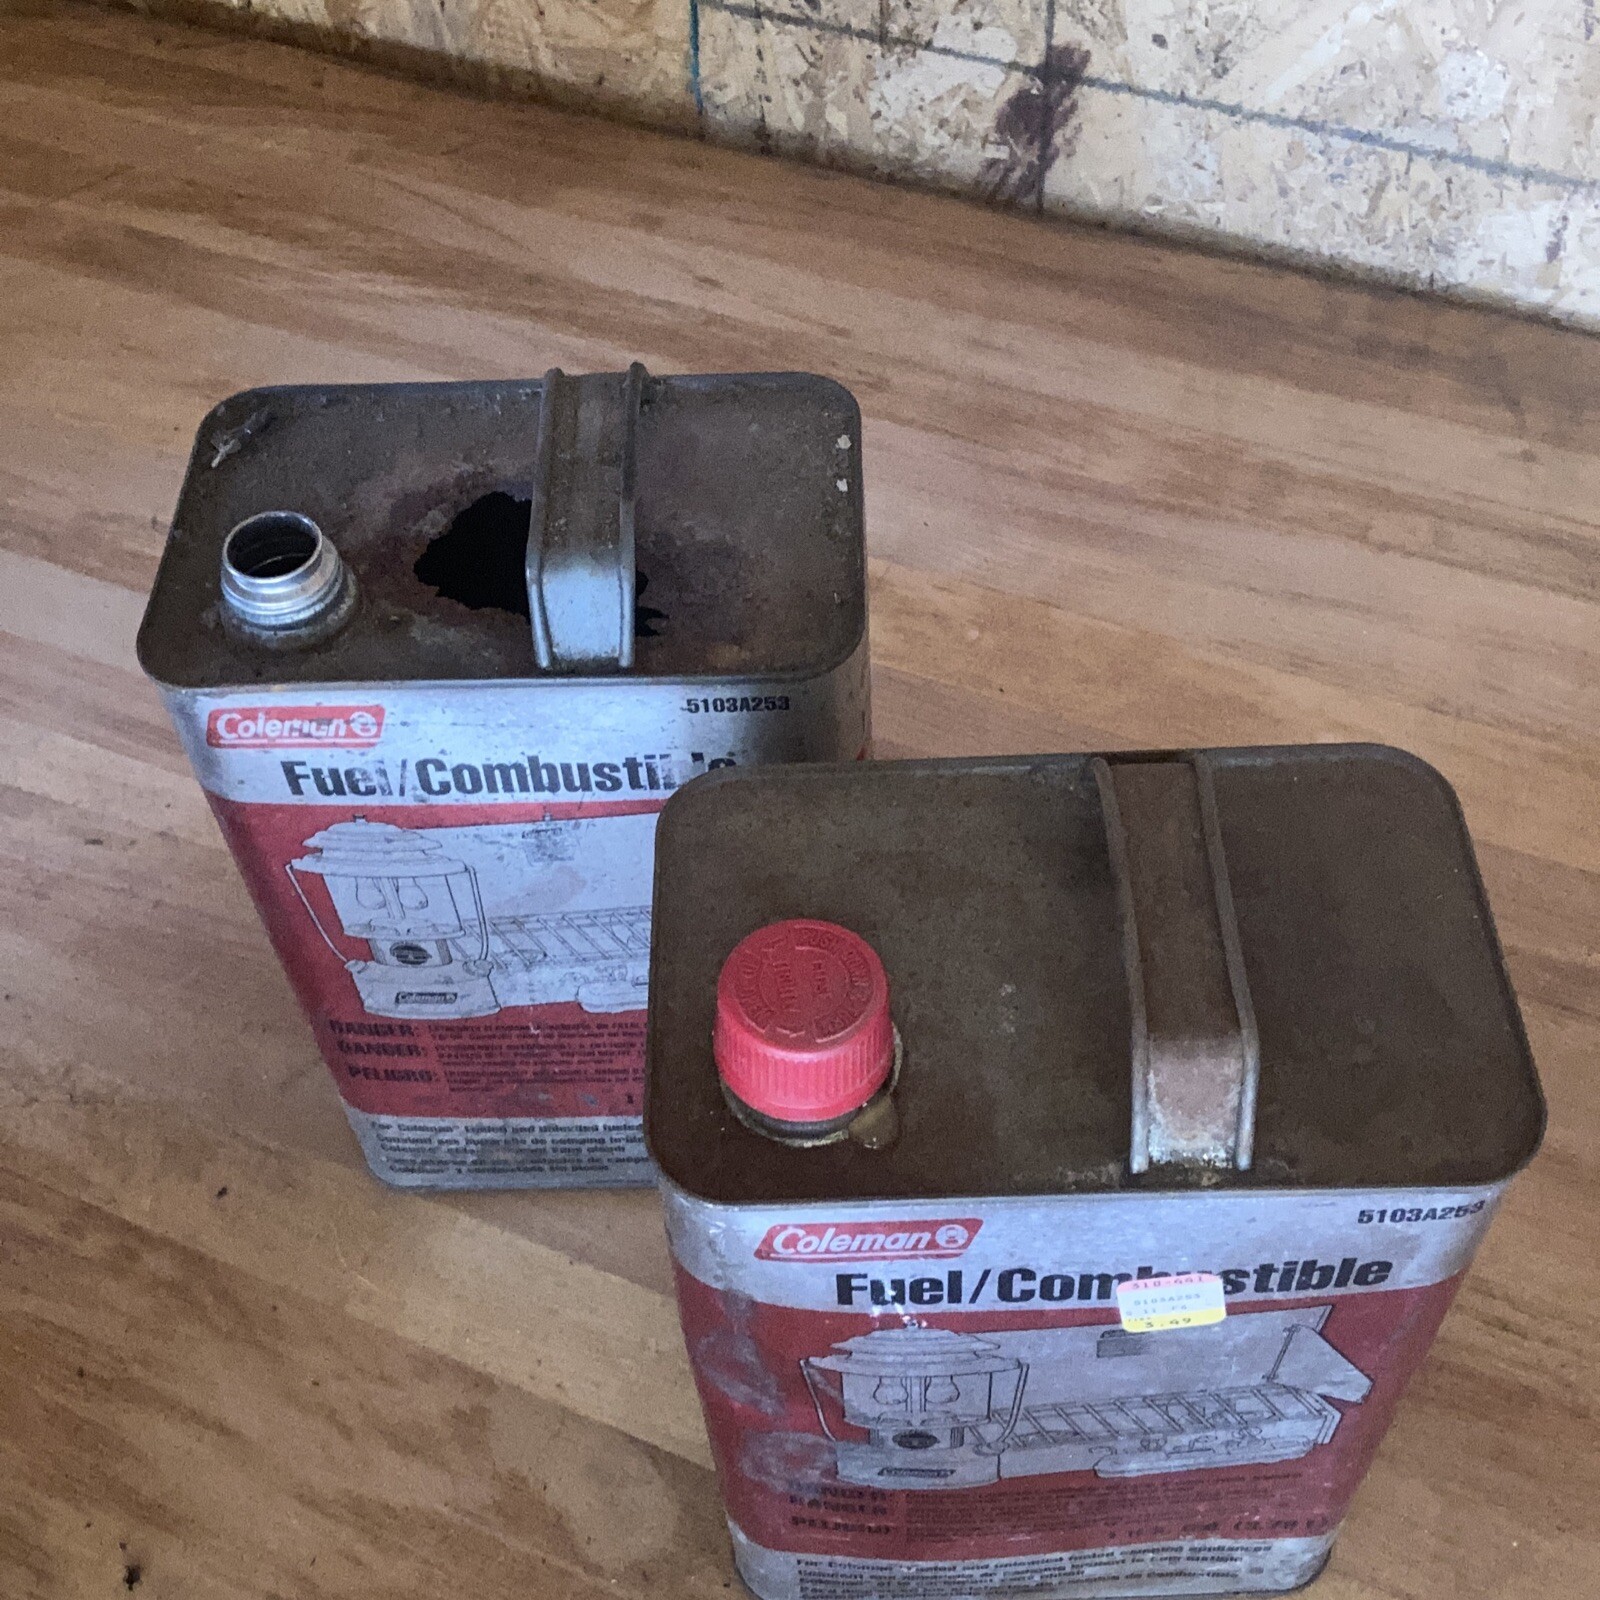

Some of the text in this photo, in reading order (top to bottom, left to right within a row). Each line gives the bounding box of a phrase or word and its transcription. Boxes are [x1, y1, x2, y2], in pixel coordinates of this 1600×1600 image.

[685, 695, 790, 714] 5103A253
[1357, 1200, 1486, 1224] 5103A253
[772, 1226, 931, 1254] Coleman
[836, 1257, 1393, 1307] Fuel/Comstible
